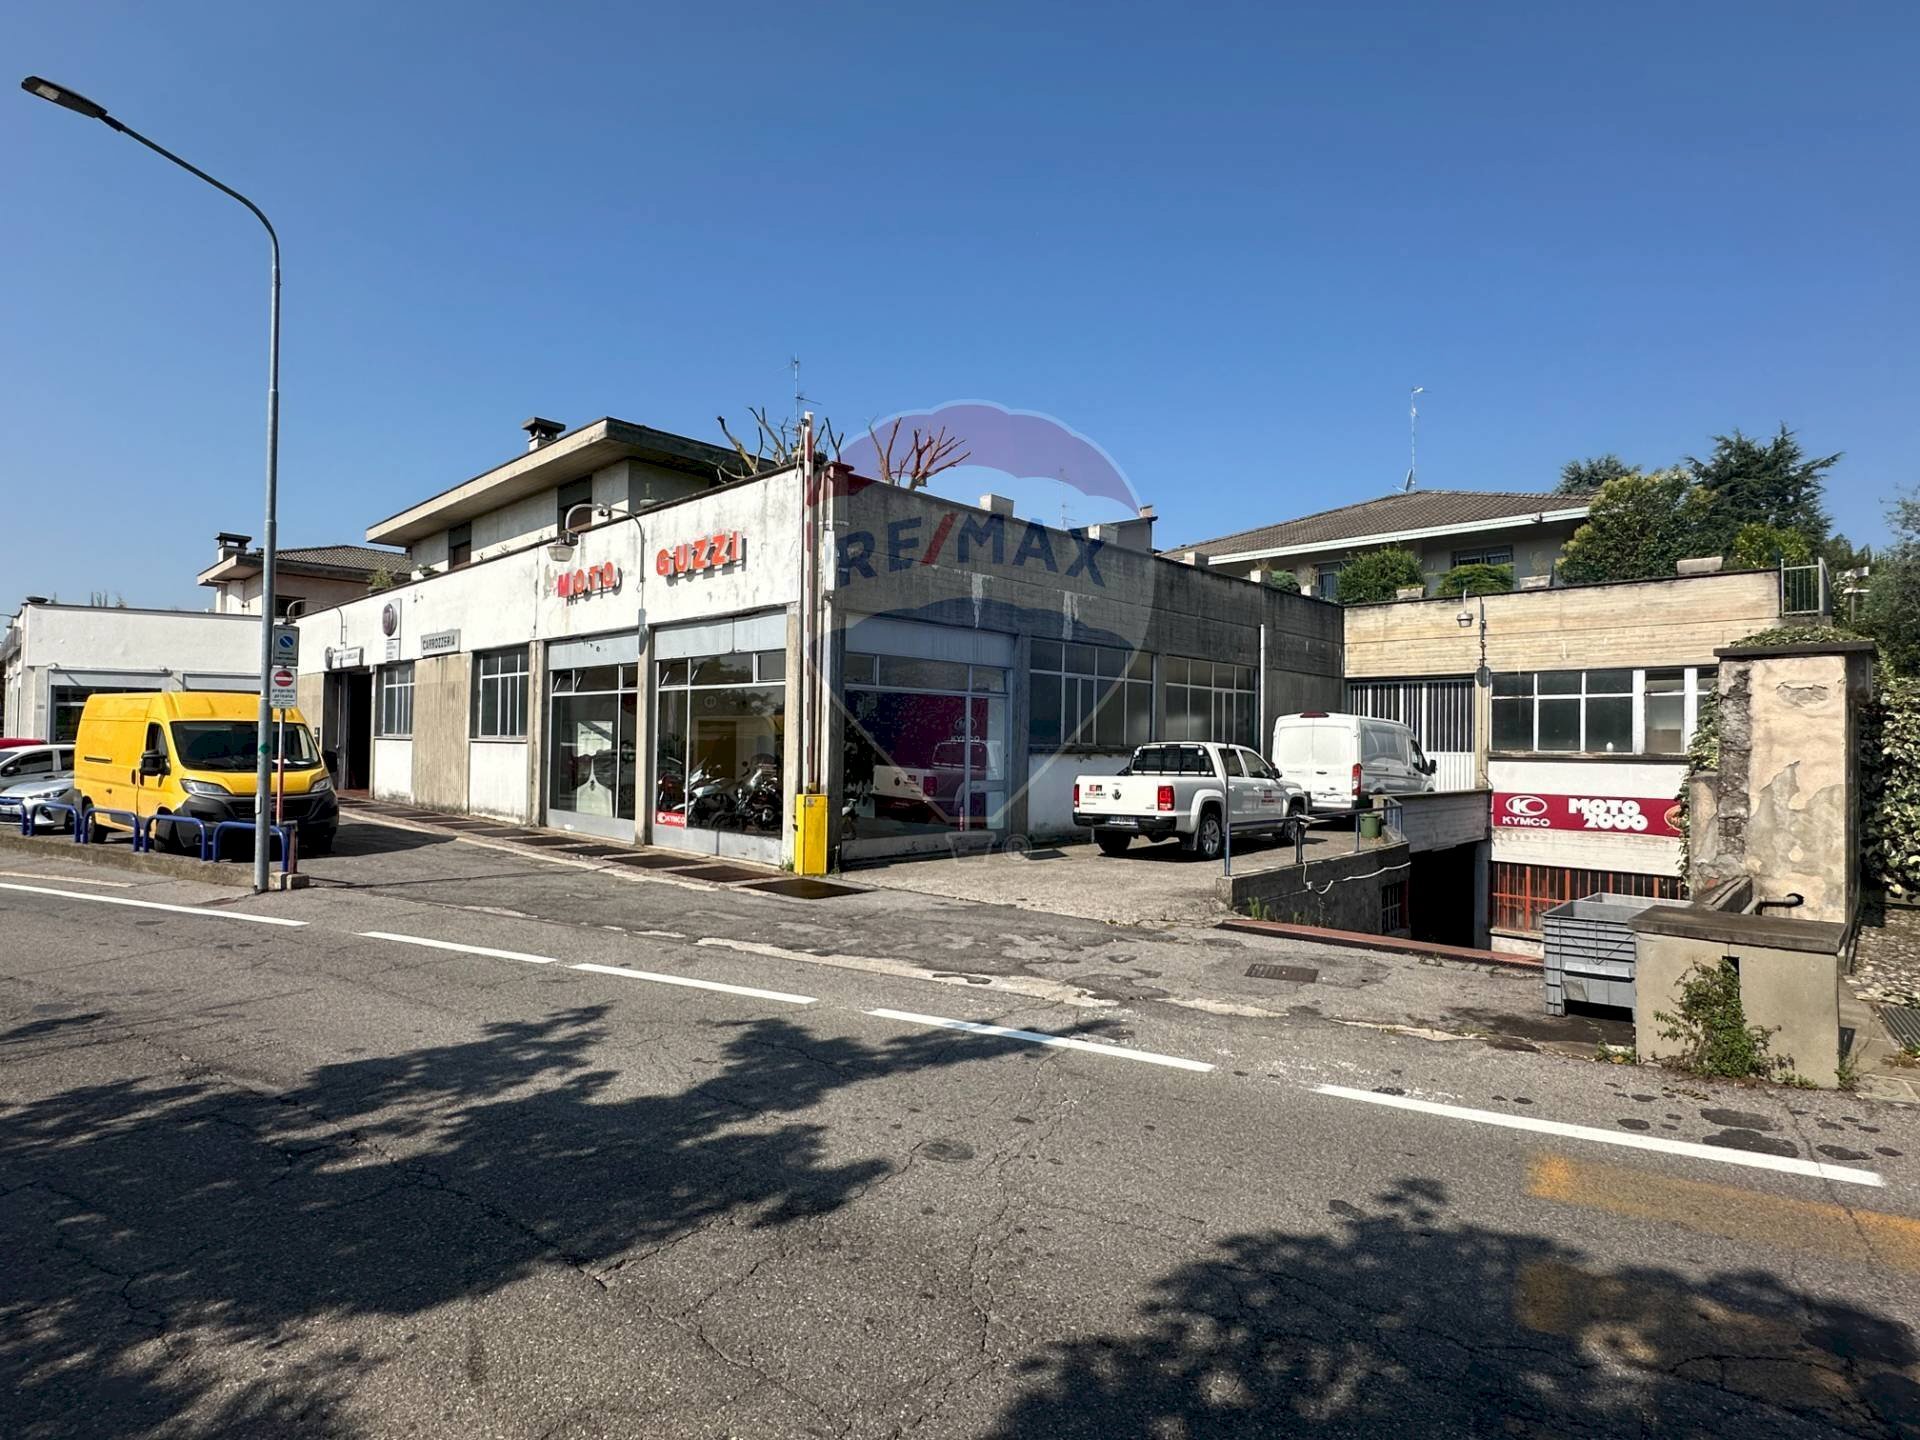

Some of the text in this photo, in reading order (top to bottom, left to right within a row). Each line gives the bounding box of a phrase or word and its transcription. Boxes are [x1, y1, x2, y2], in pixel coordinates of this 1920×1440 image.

[557, 531, 742, 598] MOTO GUZZI
[422, 635, 455, 650] CARROZZERIA
[1568, 798, 1640, 816] MOTO
[1502, 815, 1550, 827] KYMCO
[1583, 813, 1648, 831] 2000
